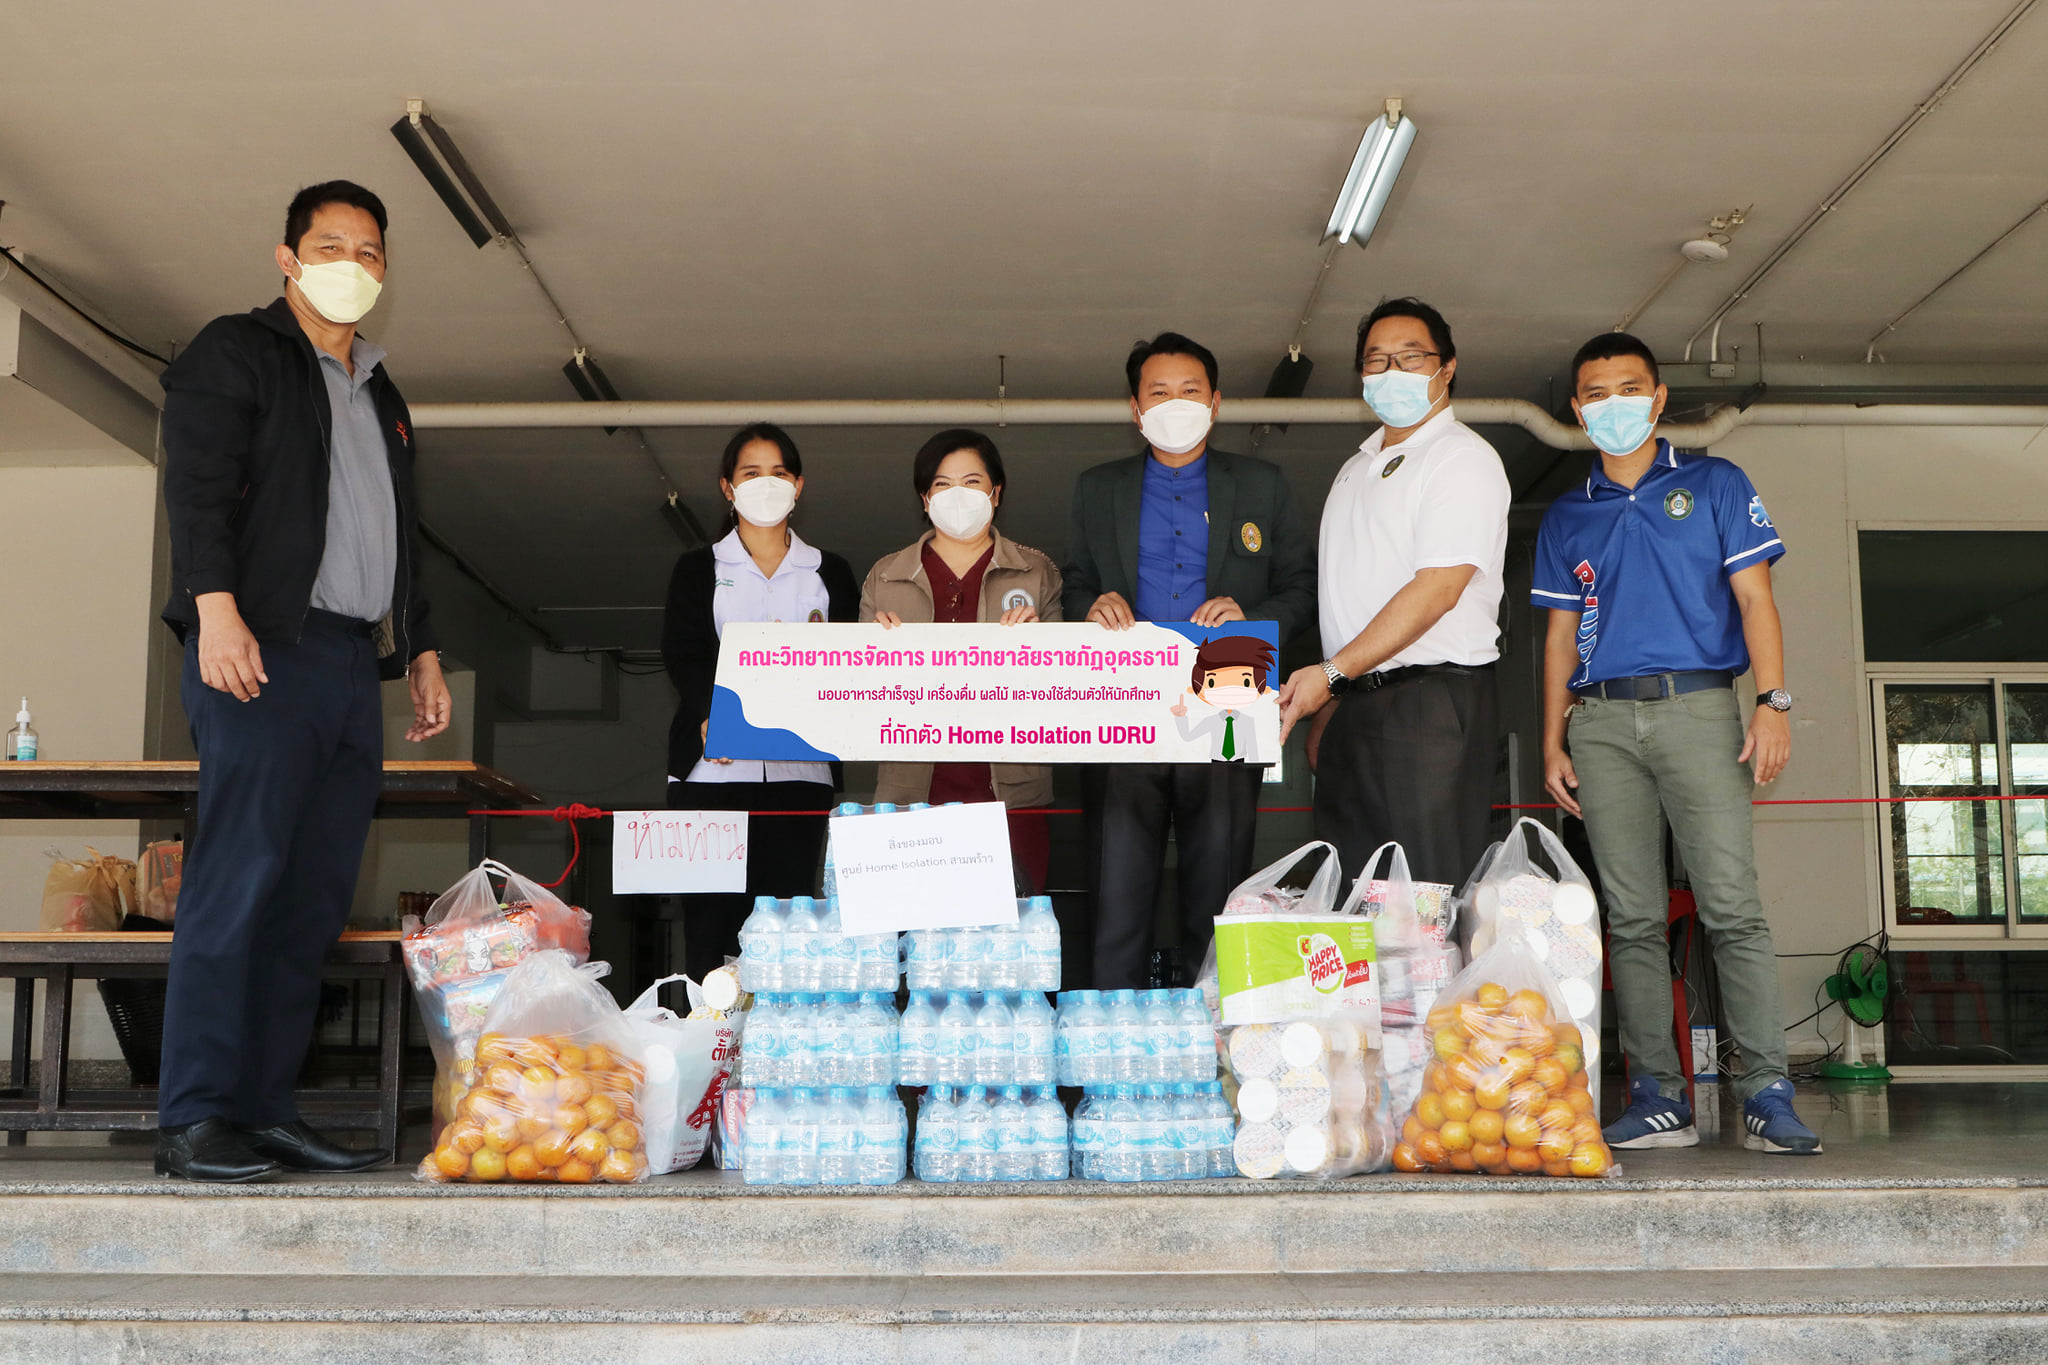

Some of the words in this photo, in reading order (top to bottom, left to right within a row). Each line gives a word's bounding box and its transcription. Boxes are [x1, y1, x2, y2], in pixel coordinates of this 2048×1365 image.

[738, 645, 925, 667] คณะวิทยาการจัดการ
[931, 644, 1179, 674] มหาวิทยาลัยราชภัฏอุดรธานี
[817, 685, 924, 705] มอบอาหารสำเร็จรูป
[927, 683, 977, 701] เครื่องดื่ม
[980, 686, 1008, 701] ผลไม้
[1012, 685, 1161, 702] และของใช้ส่วนตัวให้นักศึกษา
[880, 717, 942, 745] ที่กักตัว
[948, 726, 1004, 745] Home
[1010, 725, 1092, 745] Isolation
[1098, 726, 1156, 745] UDRU
[888, 835, 943, 850] สิ่งของมอบ
[841, 862, 863, 879] ศูนย์
[865, 862, 898, 874] Home
[901, 856, 947, 870] Isolation
[950, 851, 994, 865] สามพร้าว
[1307, 945, 1337, 971] HAPPY
[1311, 957, 1344, 987] PRICE
